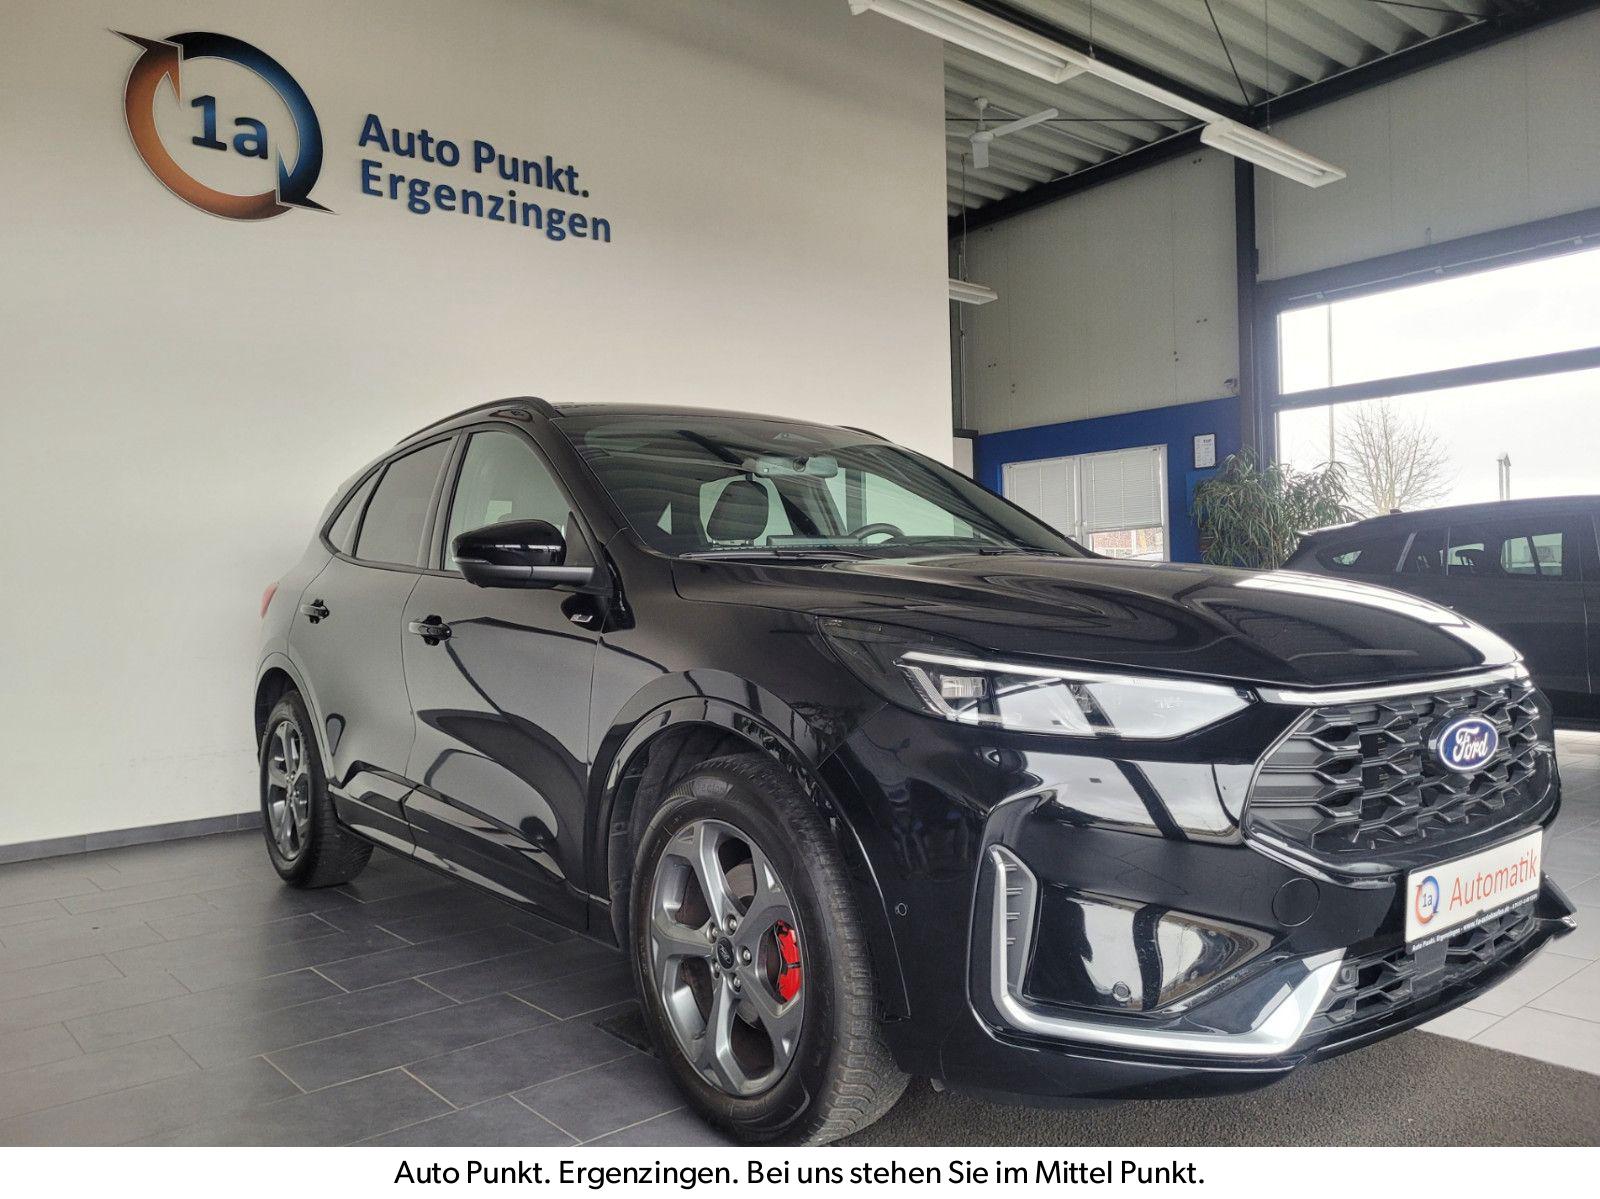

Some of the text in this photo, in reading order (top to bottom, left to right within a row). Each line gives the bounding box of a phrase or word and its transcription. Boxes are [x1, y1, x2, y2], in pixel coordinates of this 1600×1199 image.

[191, 94, 268, 160] 1a
[358, 113, 590, 198] Auto Punkt.
[361, 158, 611, 242] Ergenzingen
[1453, 727, 1488, 762] Ford
[1422, 893, 1433, 908] 1a
[1449, 849, 1538, 911] Automatik
